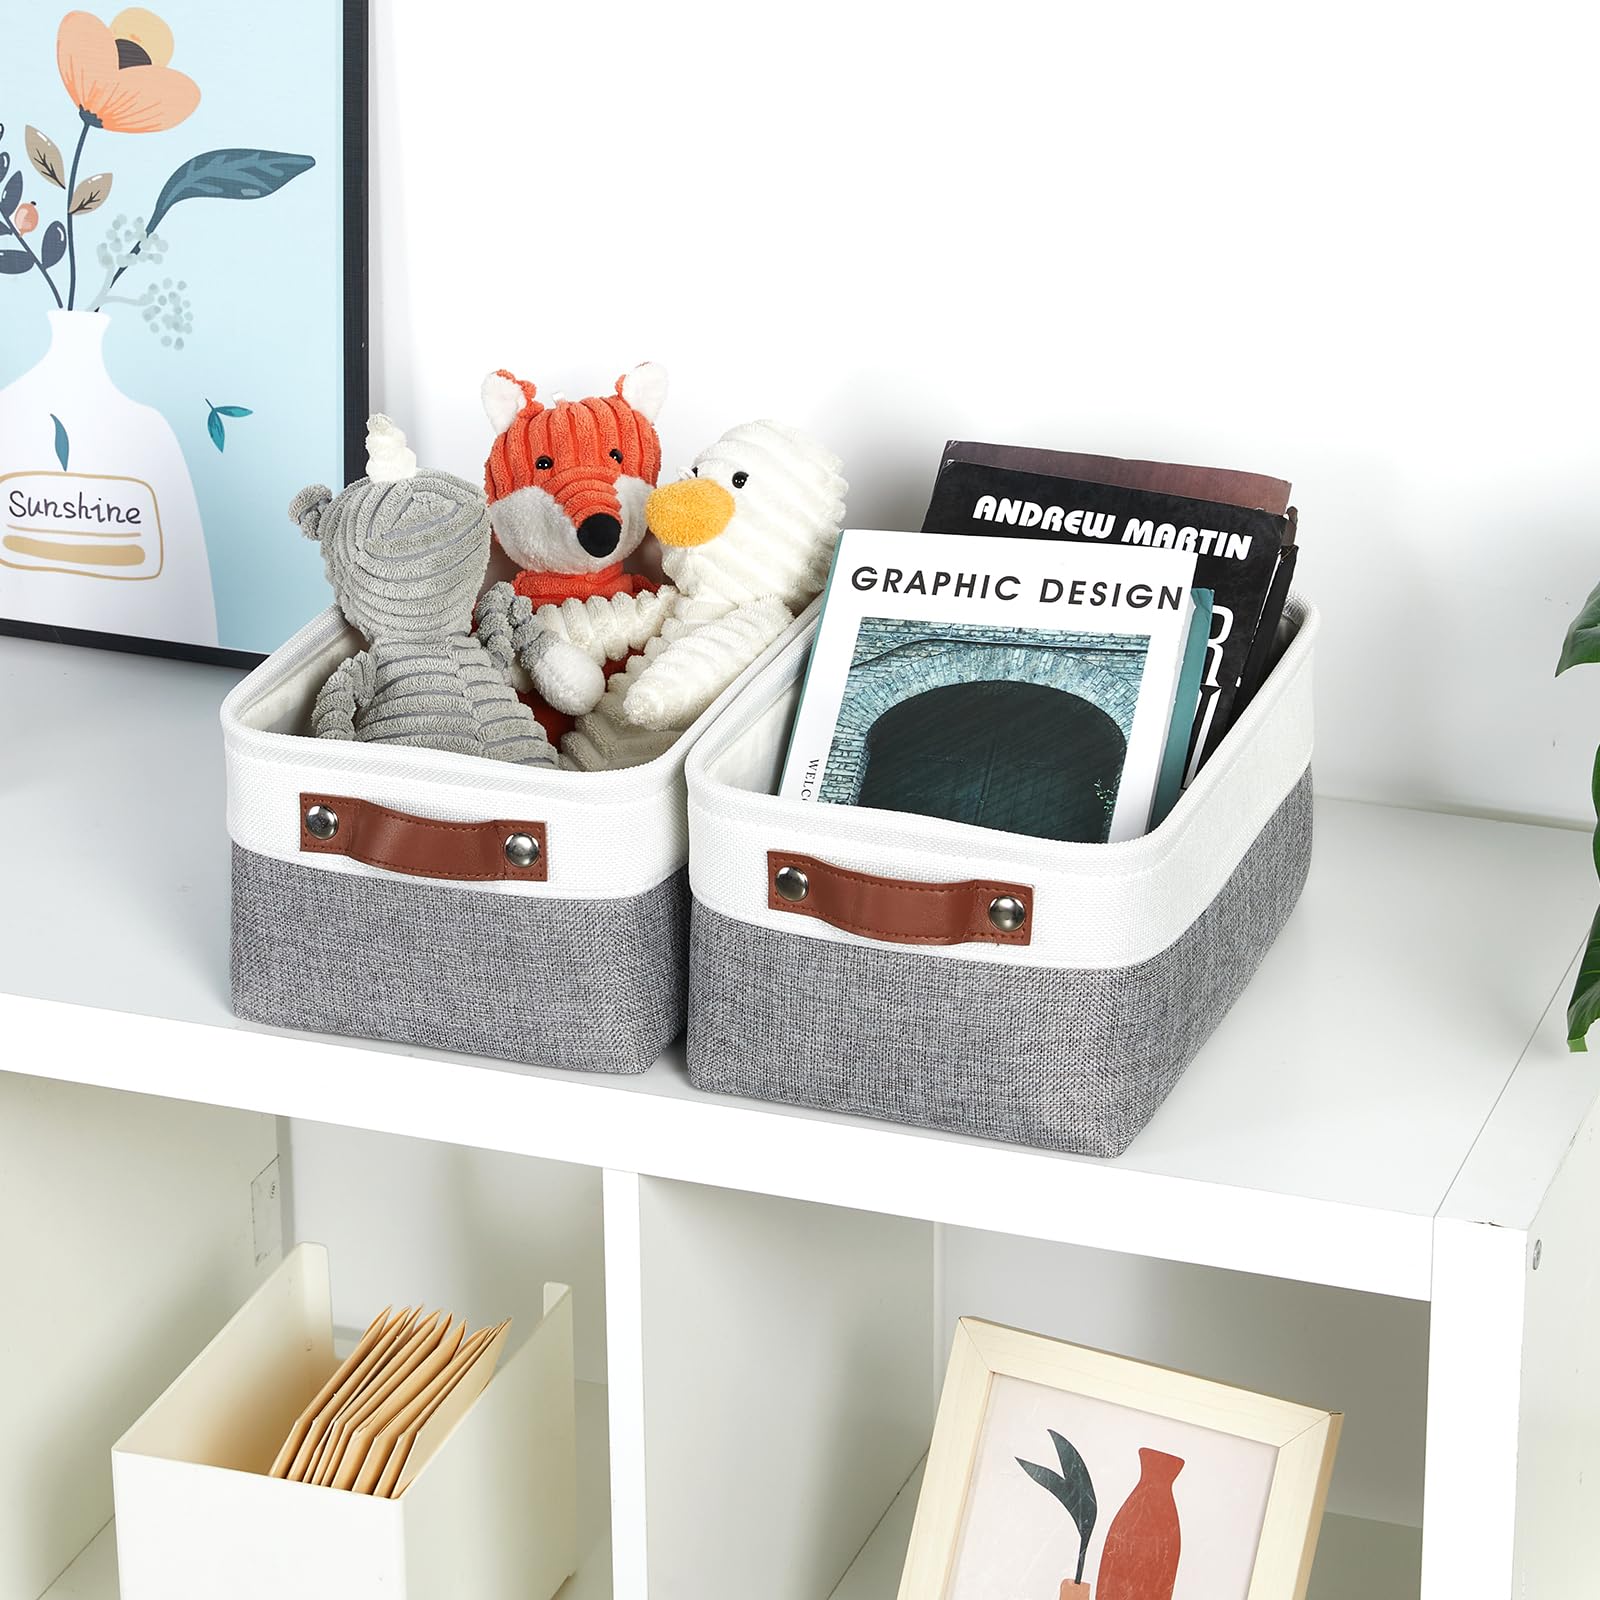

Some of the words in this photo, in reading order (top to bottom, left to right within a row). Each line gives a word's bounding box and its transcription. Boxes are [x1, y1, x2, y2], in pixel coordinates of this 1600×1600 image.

[8, 490, 142, 525] Sunshine
[972, 495, 1117, 539] ANDREW
[1120, 518, 1253, 561] MARTIN
[851, 566, 1021, 601] GRAPHIC
[1039, 578, 1183, 611] DESIGN
